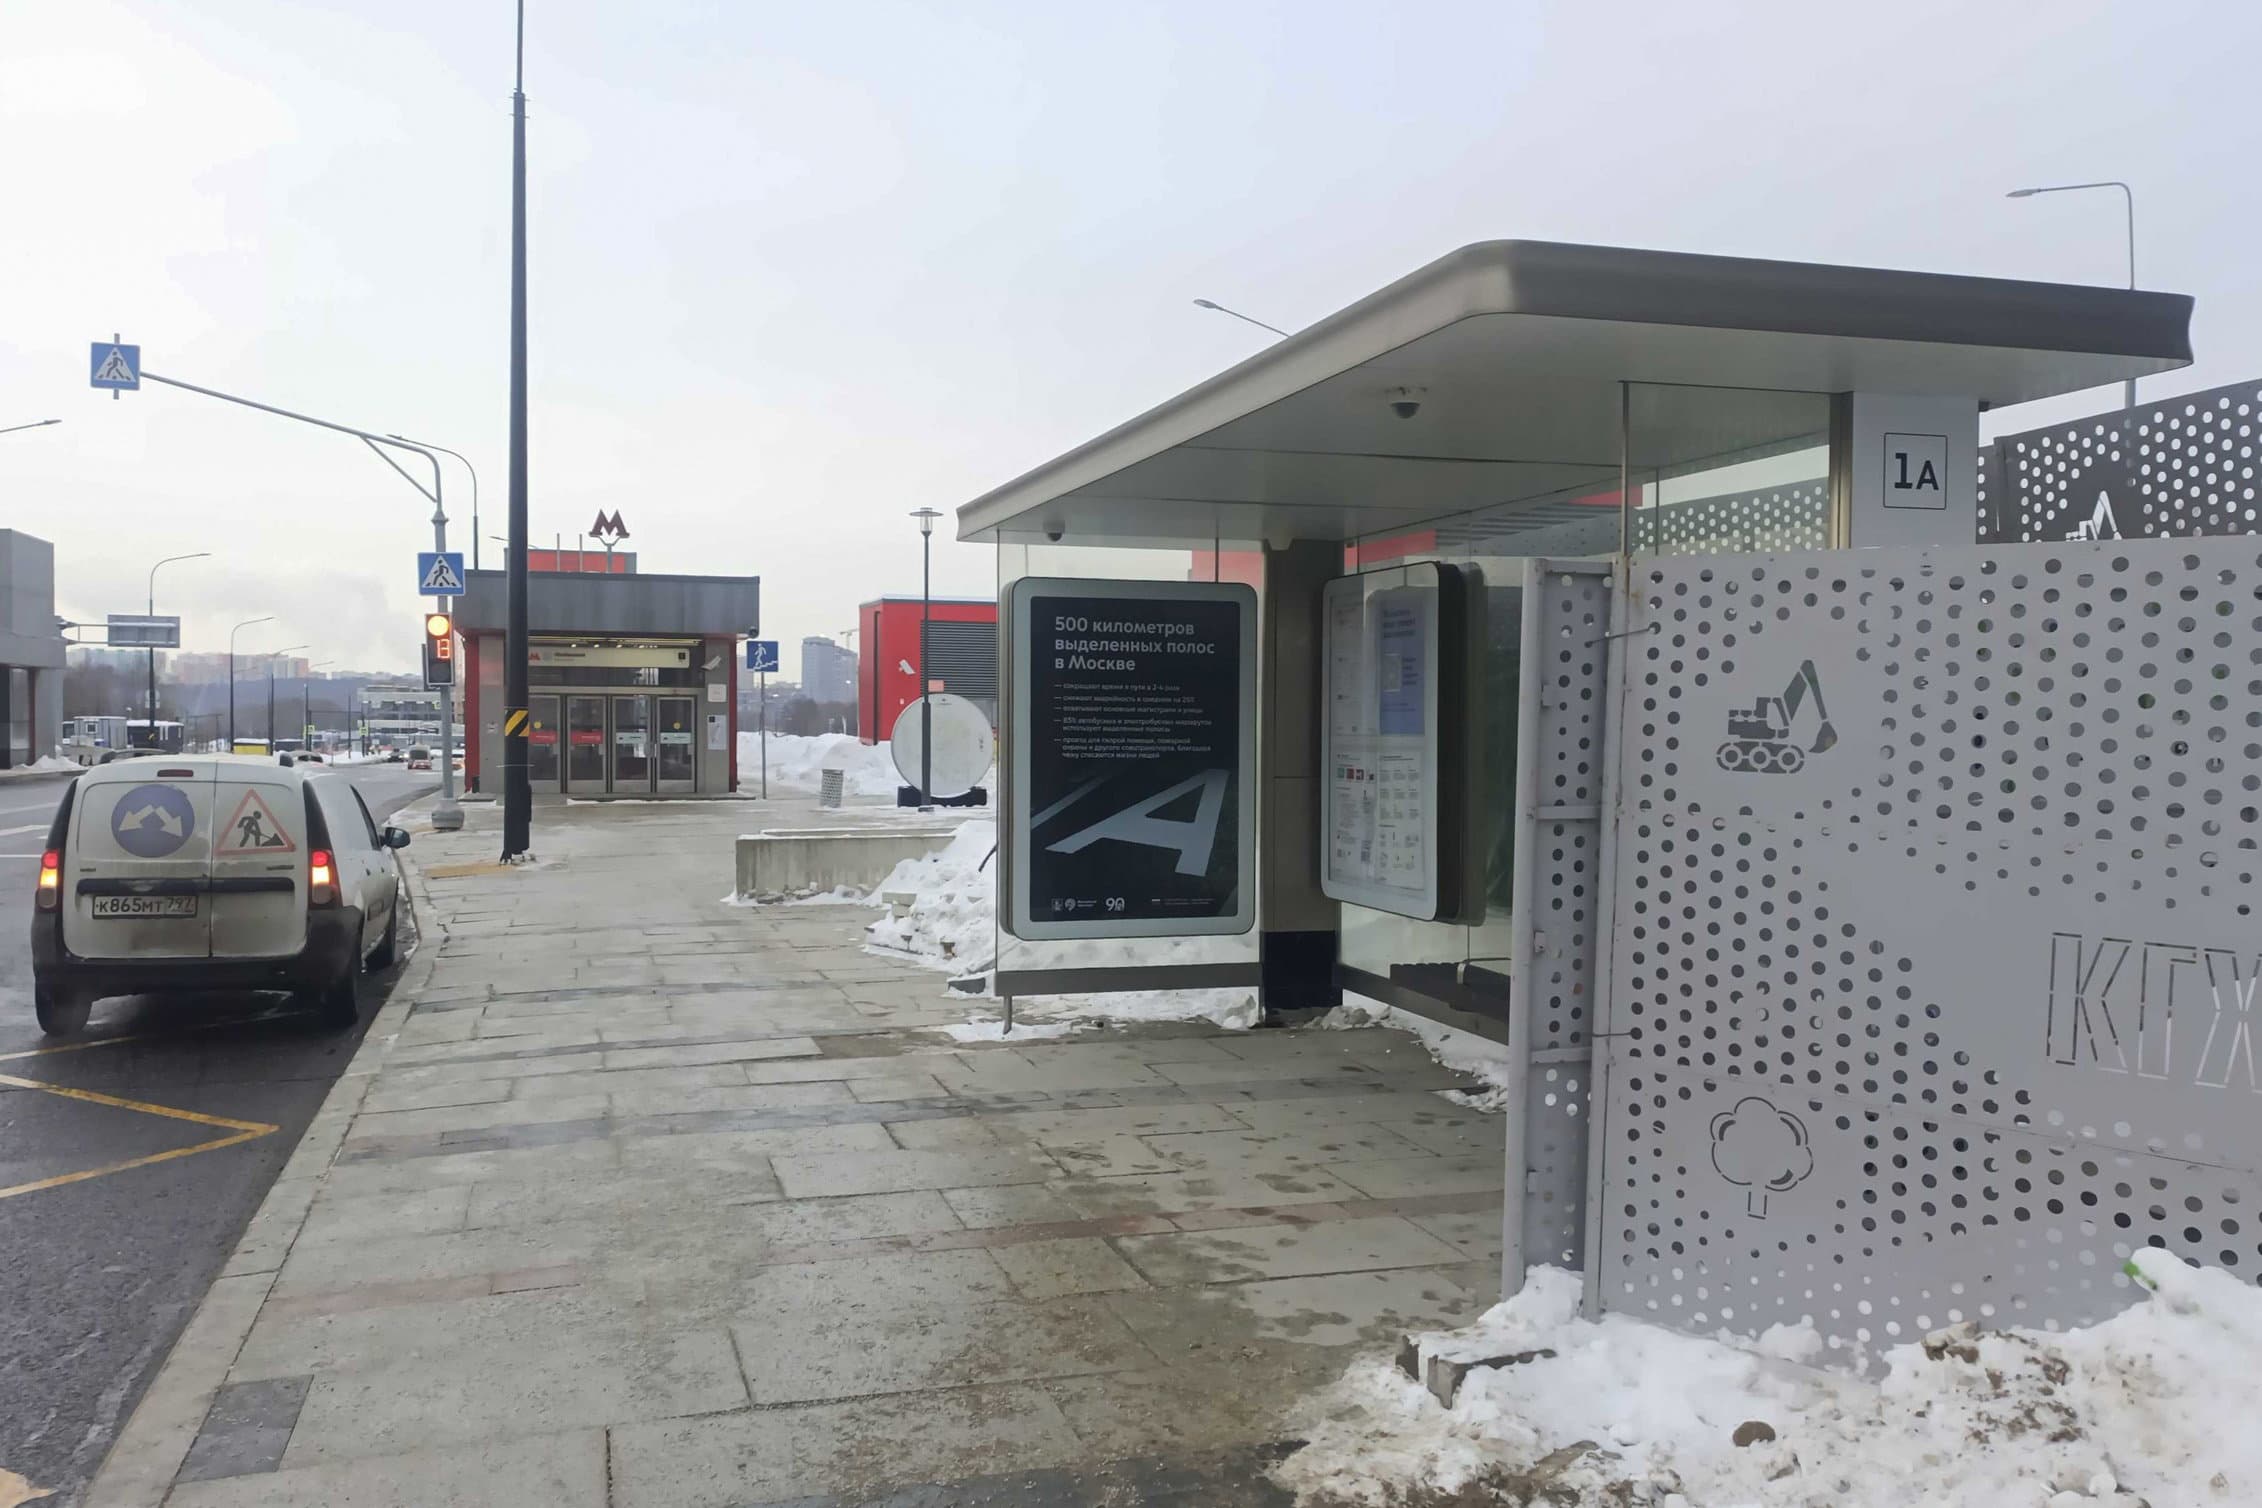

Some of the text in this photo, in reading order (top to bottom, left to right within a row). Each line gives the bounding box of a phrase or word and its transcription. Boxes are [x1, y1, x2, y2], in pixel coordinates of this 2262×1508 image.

[1894, 452, 1939, 491] 1А
[588, 509, 630, 538] М
[1055, 616, 1195, 637] 500 километров
[1055, 638, 1215, 654] выделенных полос
[1055, 655, 1136, 671] в Москве
[98, 898, 163, 914] К865МТ
